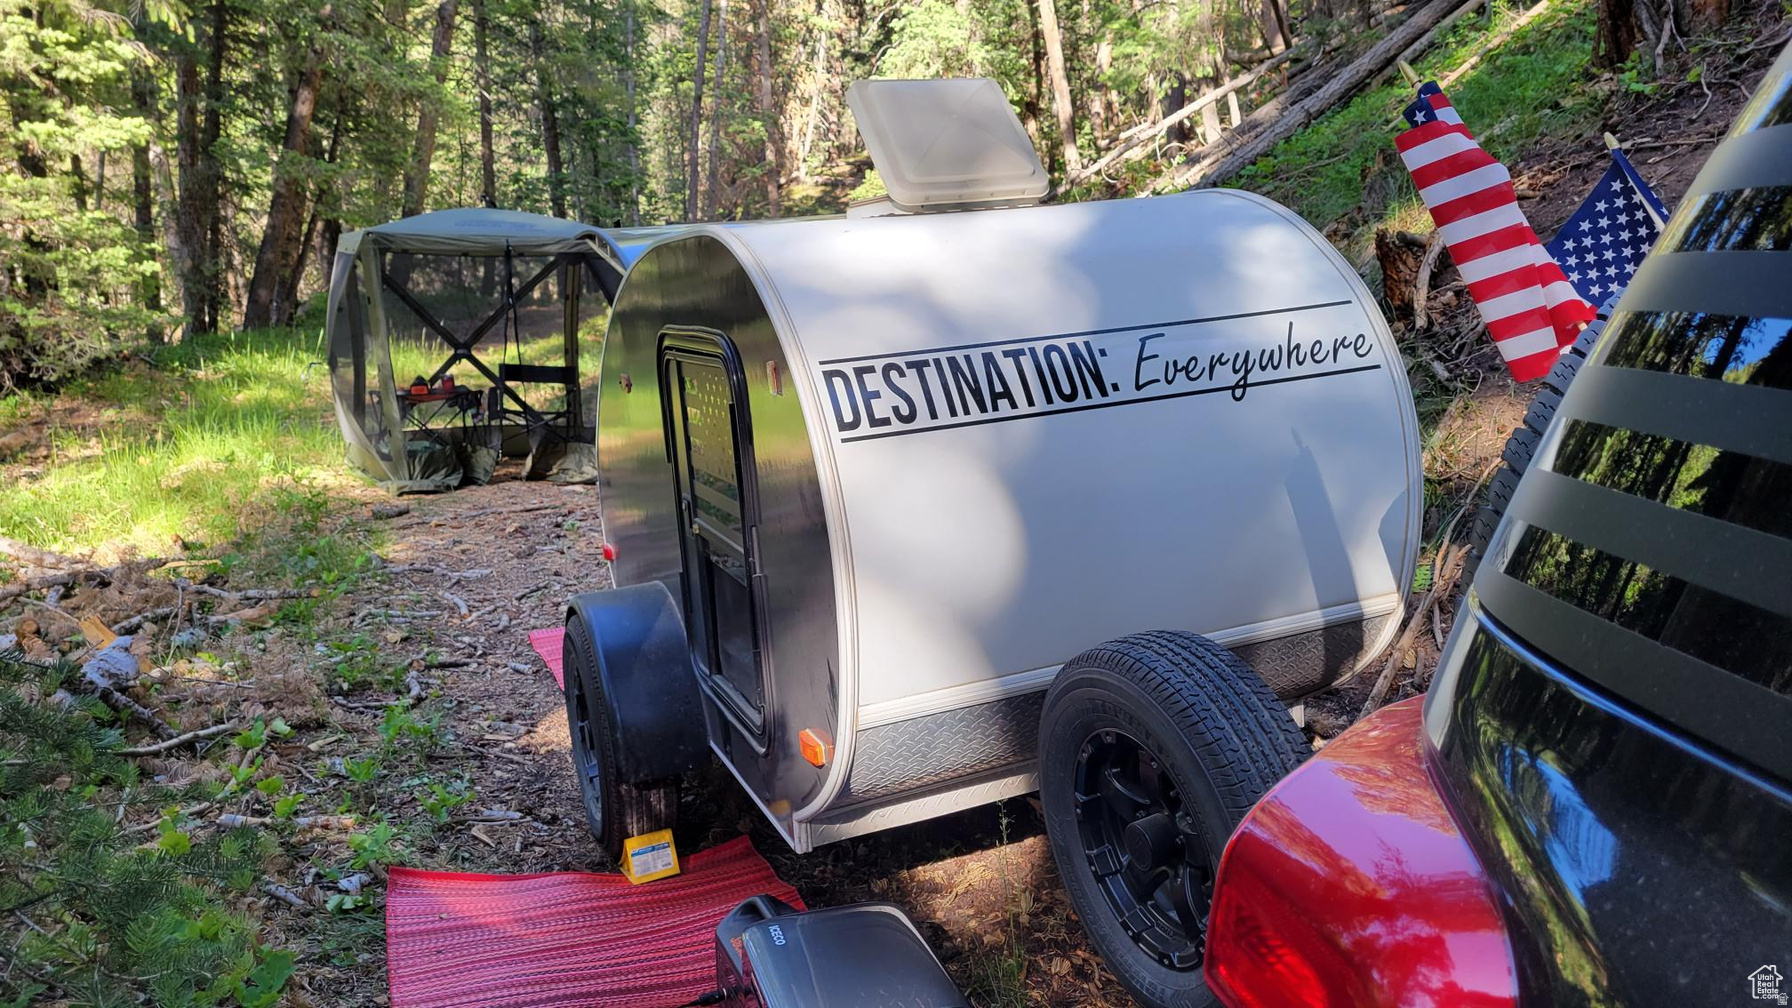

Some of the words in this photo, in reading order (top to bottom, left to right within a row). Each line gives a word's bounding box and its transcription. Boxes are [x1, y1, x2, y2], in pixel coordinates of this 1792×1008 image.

[822, 339, 1121, 433] DESTINATION:
[1134, 321, 1373, 402] Everywhere
[768, 924, 786, 946] ICECO
